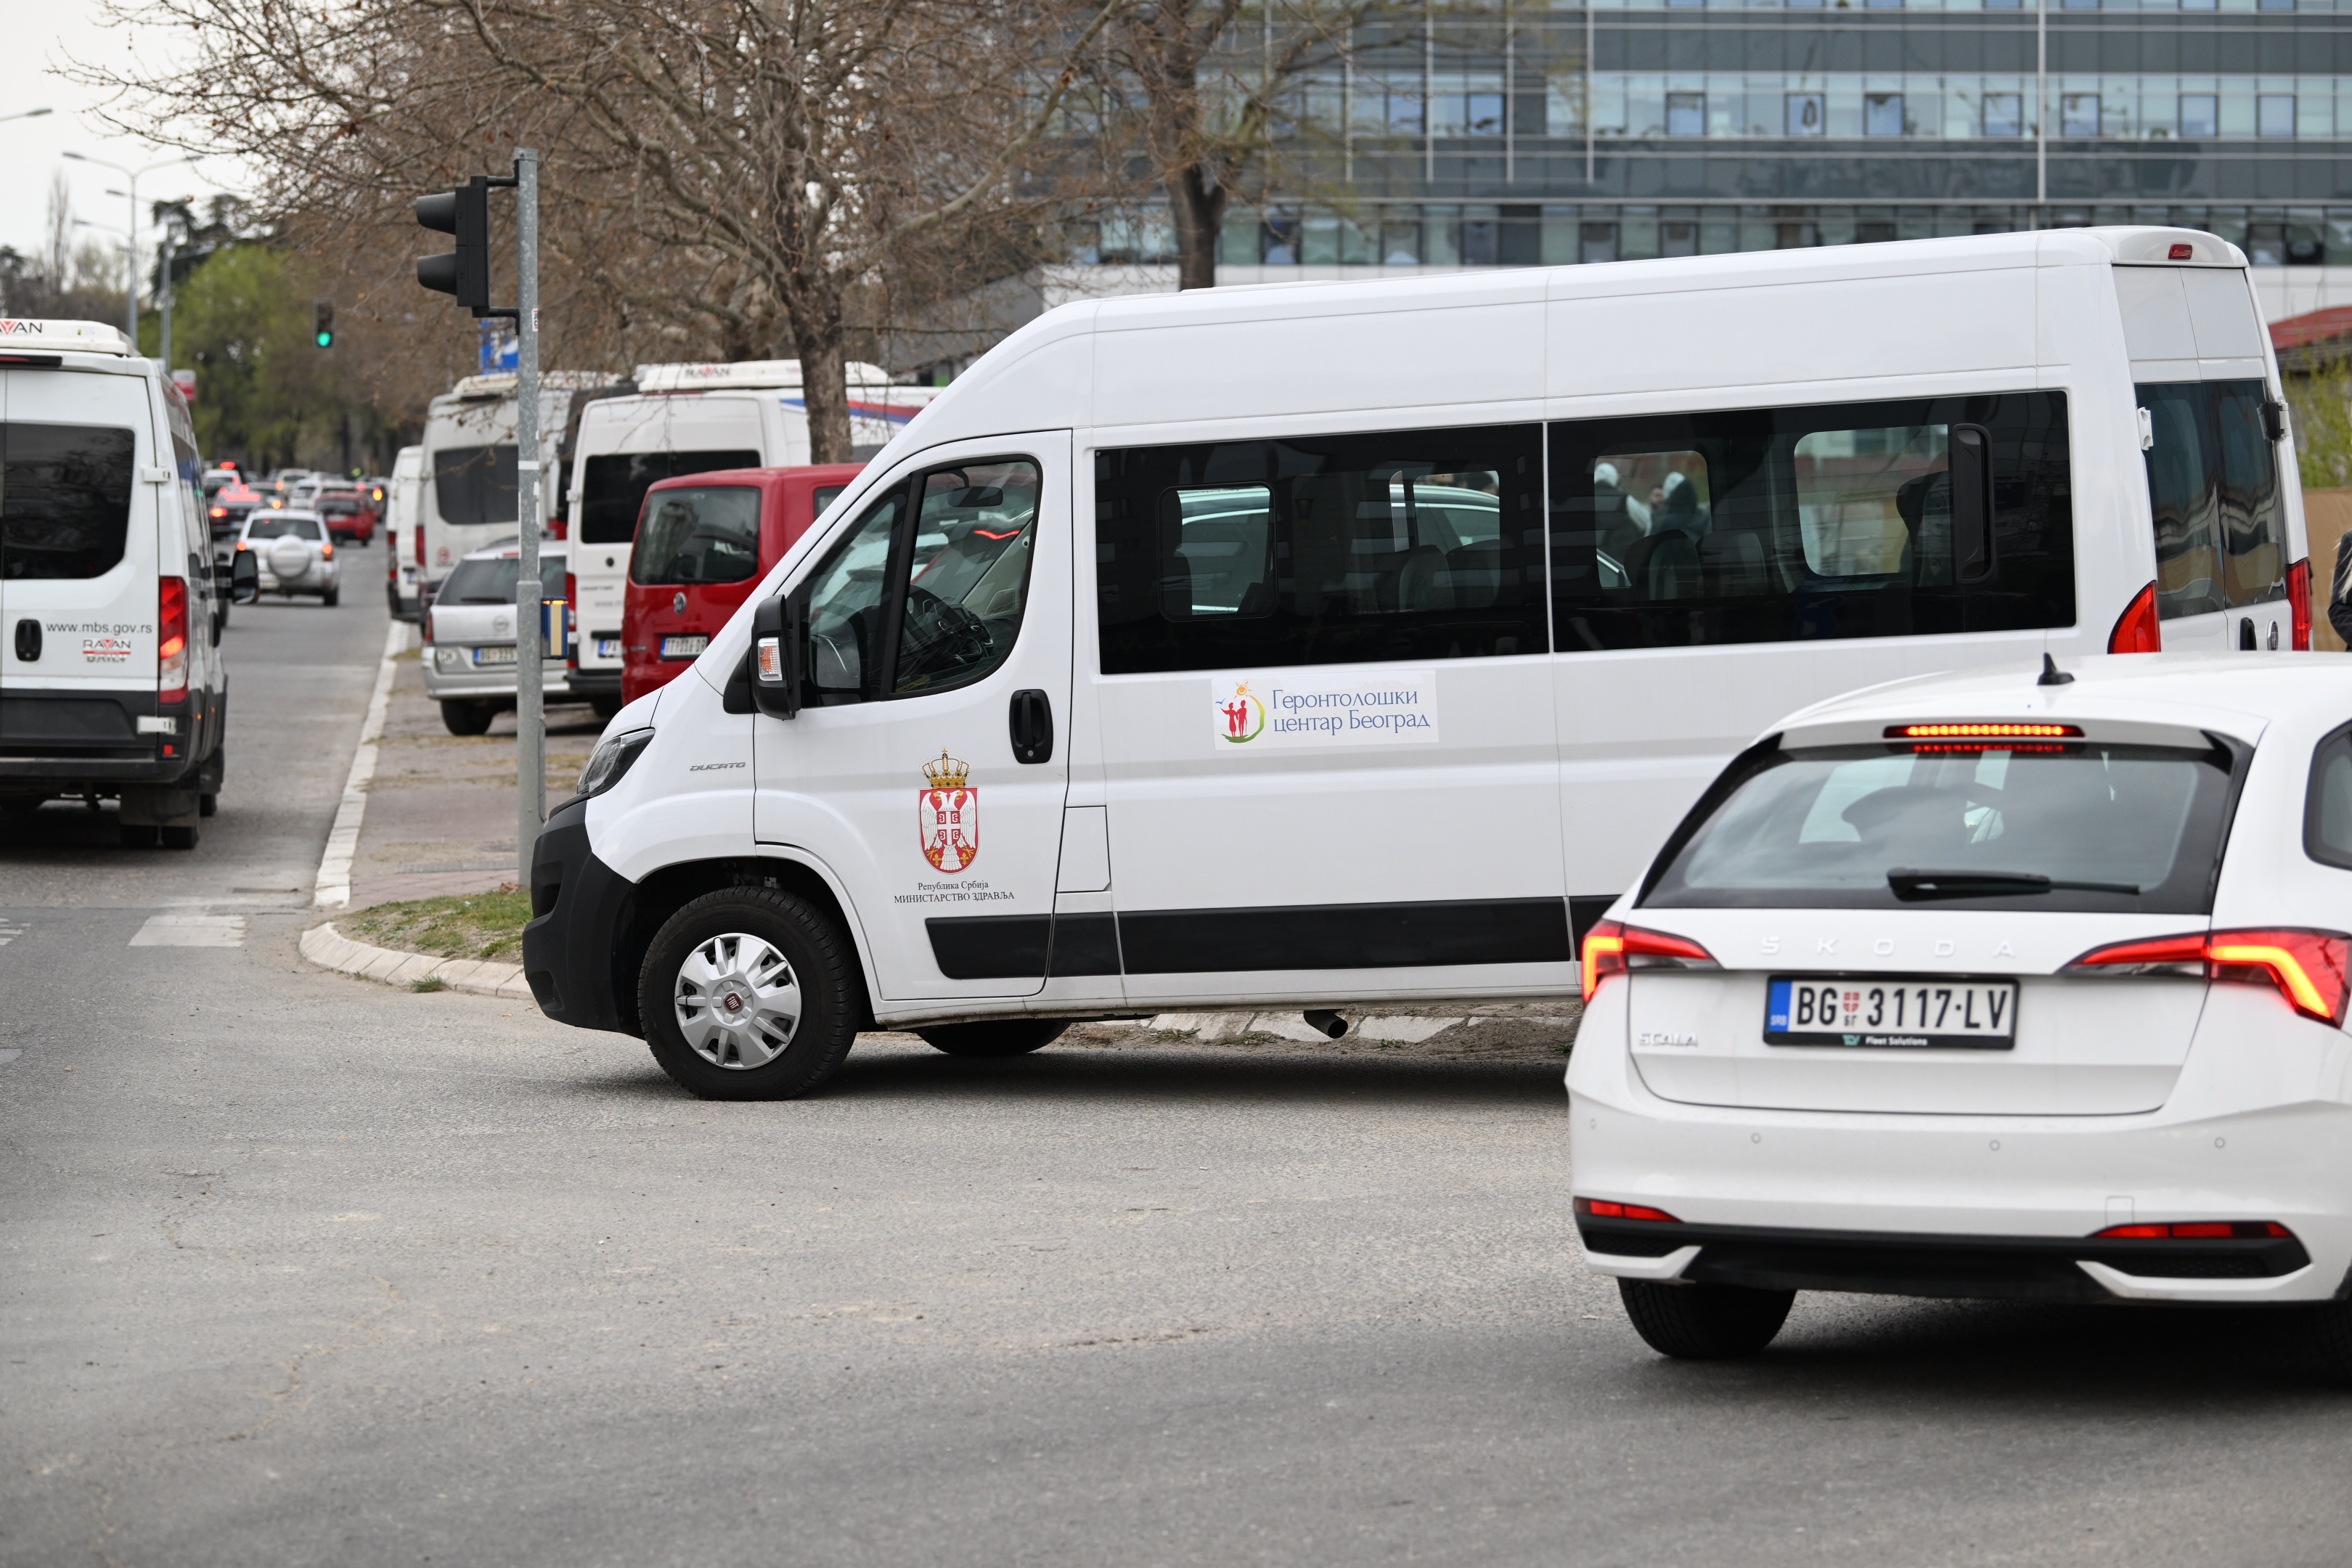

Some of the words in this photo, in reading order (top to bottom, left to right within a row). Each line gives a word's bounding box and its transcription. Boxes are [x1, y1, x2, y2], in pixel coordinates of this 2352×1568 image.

[46, 621, 152, 636] www.mbs.gov.rs
[1272, 689, 1418, 714] Геронтолошки
[1273, 714, 1343, 735] центар
[1349, 709, 1431, 733] Београд
[690, 761, 746, 771] DUCATO
[918, 882, 959, 892] Република
[961, 880, 989, 891] Србија
[894, 893, 971, 904] МИНИСТАРСТВО
[972, 891, 1015, 902] ЗДРАВЉА
[727, 995, 740, 1009] FIAT
[1797, 987, 1838, 1026] BG
[1638, 1032, 1699, 1047] SCALA
[1888, 1036, 1928, 1046] Solutions
